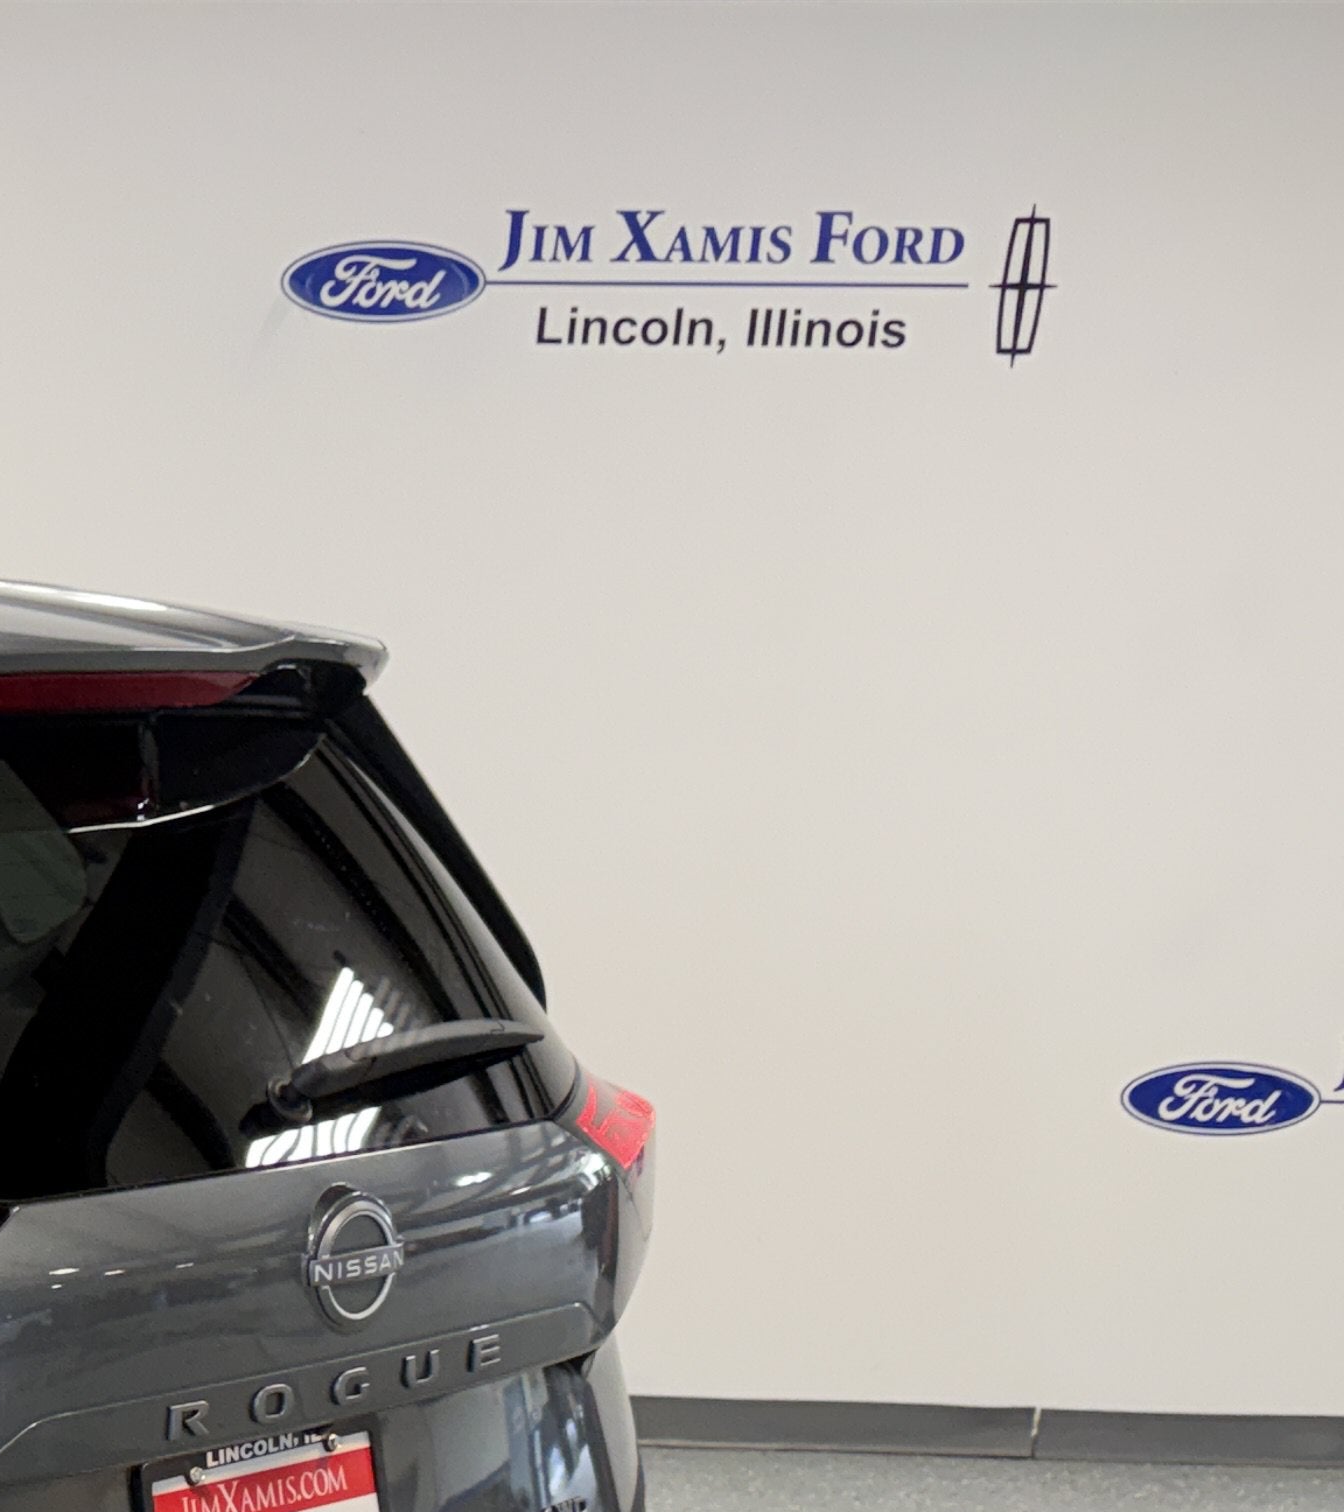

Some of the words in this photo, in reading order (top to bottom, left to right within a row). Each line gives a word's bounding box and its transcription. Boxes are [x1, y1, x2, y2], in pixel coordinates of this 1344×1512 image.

[497, 209, 595, 271] JIM
[609, 210, 792, 265] XAMIS
[811, 211, 964, 265] FORD
[320, 254, 444, 312] Ford
[536, 306, 727, 353] Lincoln,
[748, 308, 906, 349] Illinois
[1158, 1073, 1283, 1124] Ford
[314, 1250, 404, 1282] NISSAN
[166, 1333, 502, 1442] ROGUE
[206, 1432, 299, 1468] LINCOLN,
